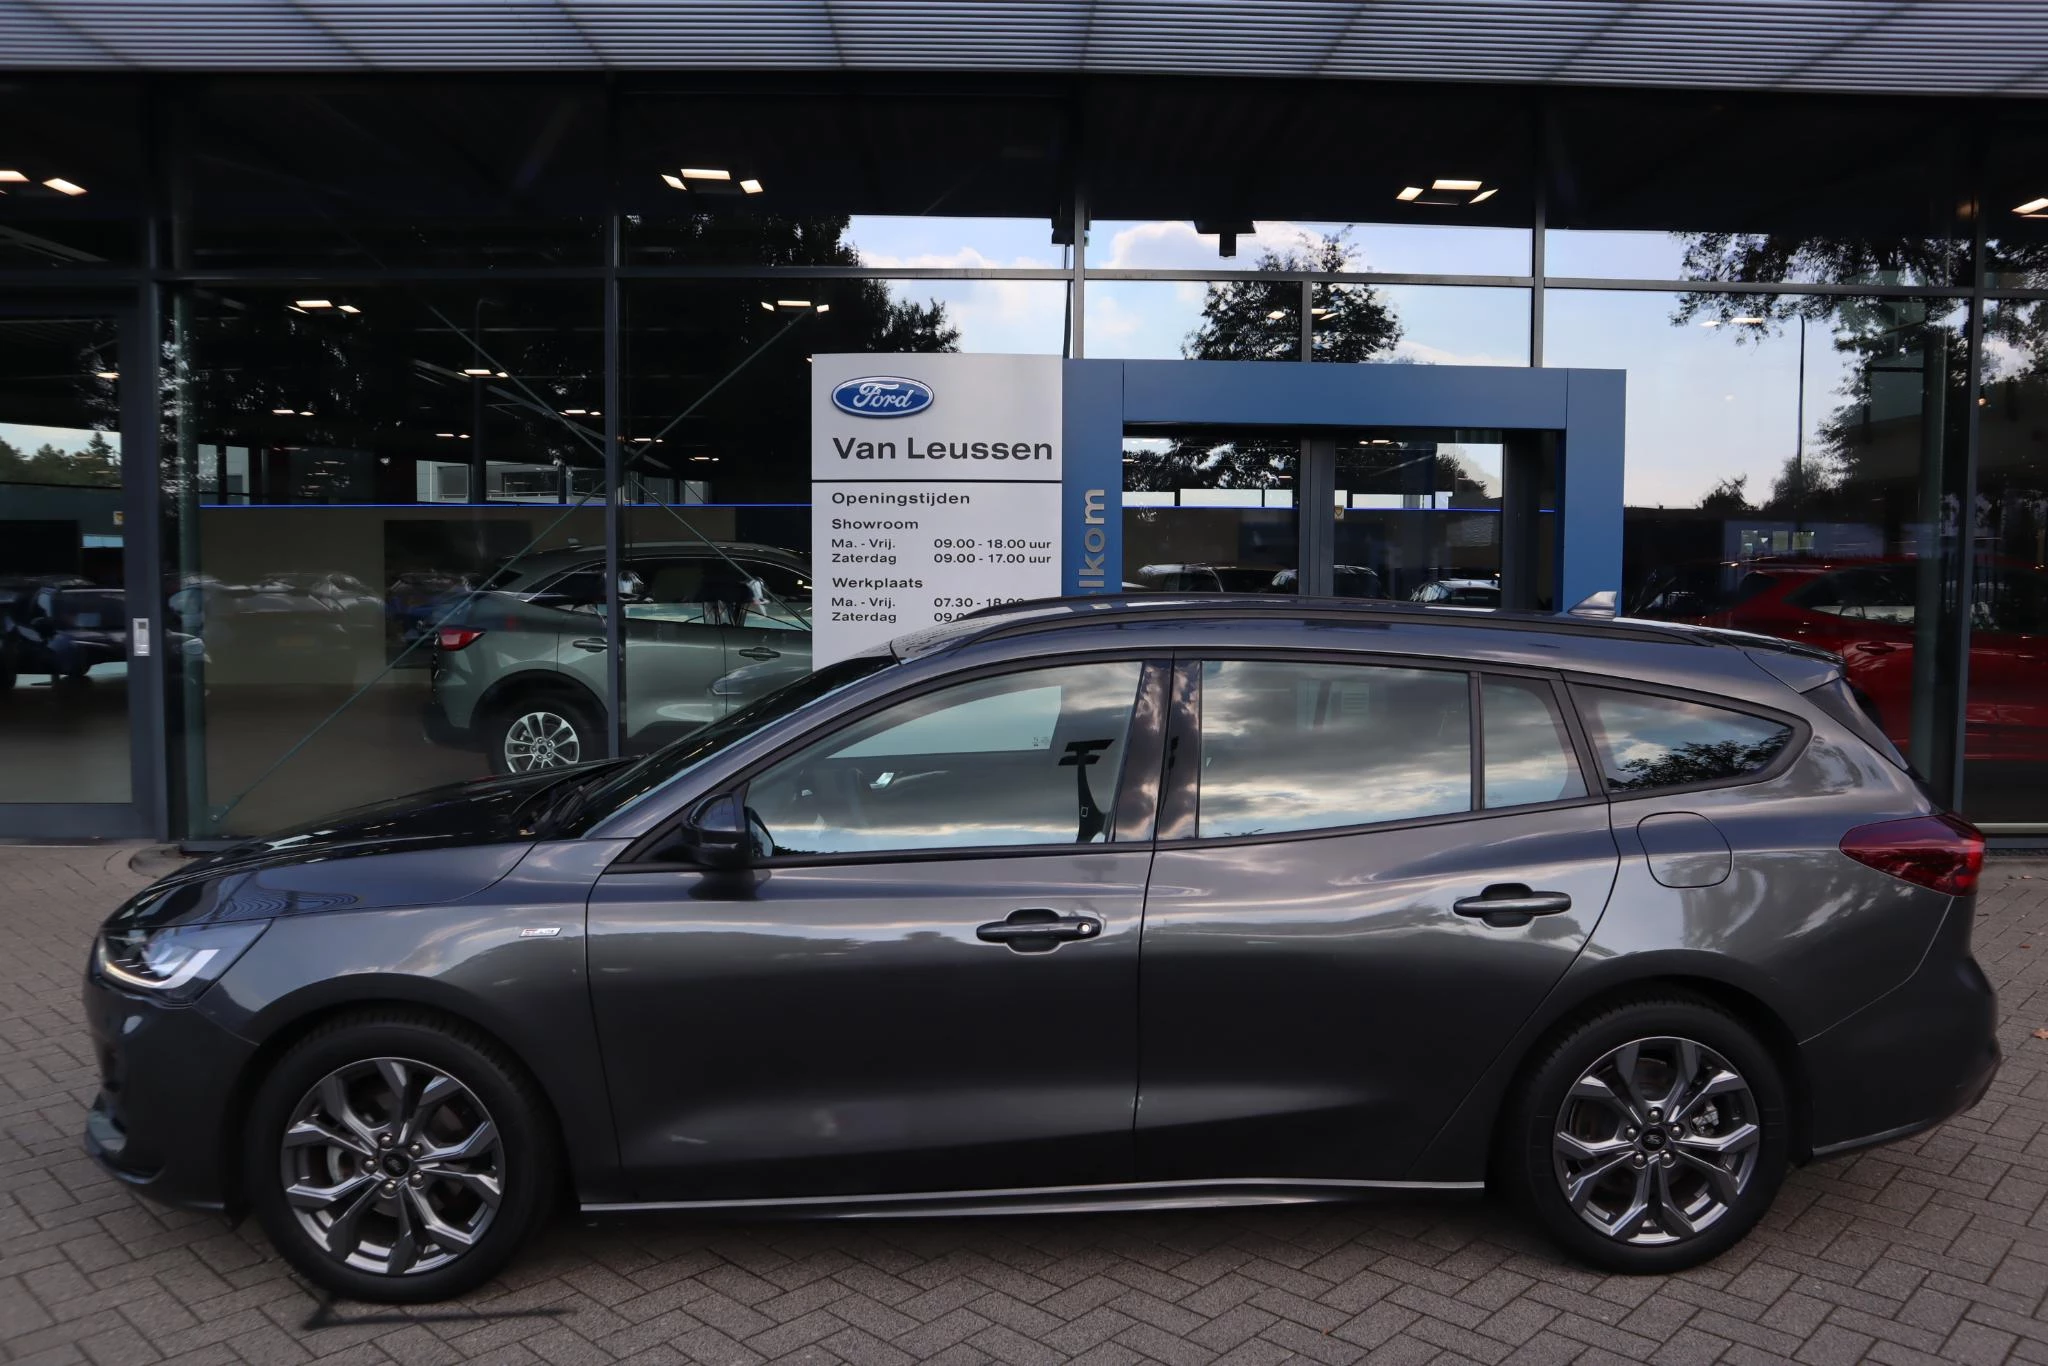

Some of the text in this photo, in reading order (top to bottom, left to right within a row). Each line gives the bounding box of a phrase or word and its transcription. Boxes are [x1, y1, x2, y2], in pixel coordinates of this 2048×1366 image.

[853, 382, 913, 408] Ford
[831, 436, 1053, 461] Van Leussen
[831, 492, 970, 507] Openingstijden
[831, 518, 919, 530] Showroom
[831, 538, 857, 549] Ma.
[868, 538, 896, 551] Vrij.
[933, 538, 976, 549] 09.00
[986, 538, 1026, 549] 18.00
[1029, 541, 1052, 549] uur
[831, 553, 897, 566] Zaterdag
[933, 553, 976, 564] 09.00
[988, 553, 1026, 564] 17.00
[1028, 555, 1052, 564] uur
[831, 577, 924, 591] Werkplaats
[831, 597, 857, 607] Ma.
[868, 597, 896, 610] Vrij.
[933, 597, 974, 608] 07.30
[831, 611, 897, 624] Zaterdag
